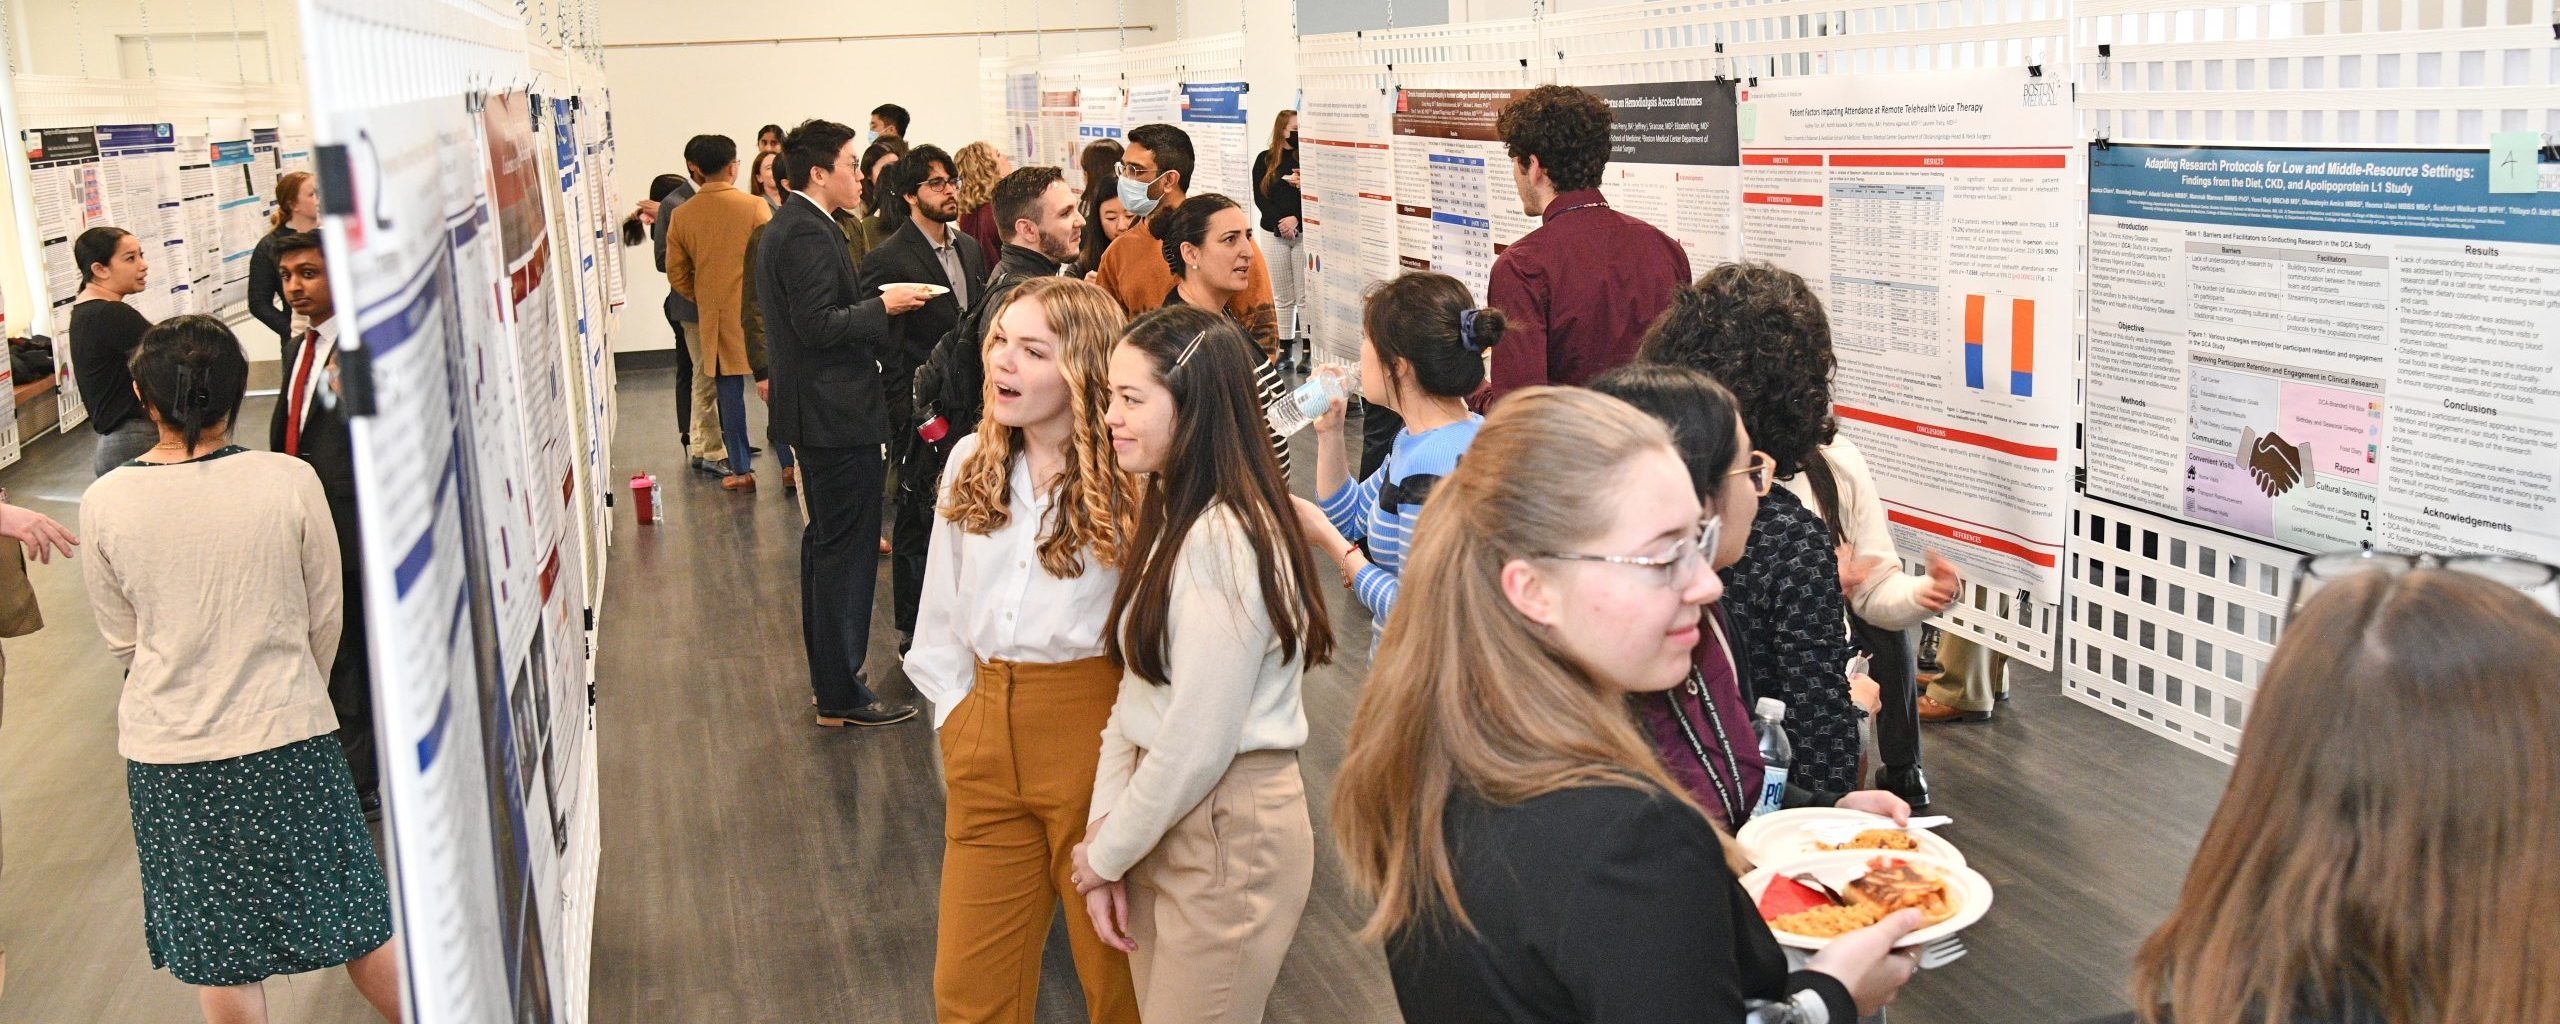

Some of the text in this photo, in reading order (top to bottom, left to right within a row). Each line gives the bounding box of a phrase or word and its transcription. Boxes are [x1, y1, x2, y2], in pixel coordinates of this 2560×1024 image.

[2024, 82, 2054, 96] BOSTON
[1624, 98, 1658, 109] Hemodialysis
[1658, 98, 1676, 107] Access
[1676, 97, 1702, 107] Outcomes
[2023, 95, 2057, 107] MEDICAL
[1790, 103, 1983, 118] Patient Factors Impacting Attendance at Remote Telehealth Voice Therapy
[1674, 122, 1690, 130] Elizabeth
[1690, 122, 1700, 130] King,
[1611, 135, 1622, 143] School
[1655, 135, 1670, 143] Medical
[1670, 135, 1682, 143] Center
[1681, 134, 1704, 144] Department
[2144, 157, 2474, 182] Adapting Research Protocols for Low and Middle-Resource Settings:
[2182, 175, 2412, 196] Findings from the Diet, CKD, and Apolipoprotein L1 Study
[2117, 221, 2148, 231] Introduction
[2202, 231, 2222, 239] Barriers
[2222, 232, 2232, 240] and
[2232, 233, 2260, 242] Facilitators
[2260, 235, 2267, 243] to
[2267, 235, 2297, 247] Conducting
[2297, 237, 2323, 246] Research
[2323, 239, 2330, 247] in
[2329, 239, 2339, 247] the
[2339, 240, 2354, 248] DCA
[2354, 241, 2371, 251] Study
[2222, 246, 2241, 254] Barriers
[2465, 245, 2499, 257] Results
[2317, 254, 2347, 264] Facilitators
[2400, 256, 2414, 264] Lack
[2422, 258, 2465, 269] understanding
[2483, 262, 2494, 270] the
[2412, 268, 2444, 276] addressed
[2444, 270, 2453, 278] by
[2453, 270, 2482, 280] improving
[2482, 274, 2528, 283] communication
[2528, 276, 2541, 284] with
[2400, 306, 2412, 315] The
[2412, 307, 2433, 317] burden
[2440, 310, 2454, 319] data
[2454, 312, 2481, 322] collection
[2494, 316, 2526, 326] addressed
[2526, 319, 2534, 328] by
[2118, 321, 2145, 333] Objective
[2188, 330, 2203, 339] Figure
[2207, 332, 2225, 341] Various
[2225, 335, 2250, 345] strategies
[2250, 339, 2274, 349] employed
[2274, 341, 2282, 349] for
[2282, 343, 2311, 354] participant
[2311, 347, 2336, 357] retention
[2336, 351, 2348, 359] and
[2348, 353, 2383, 363] engagement
[2192, 339, 2200, 347] the
[2200, 340, 2212, 348] DCA
[2211, 342, 2225, 351] Study
[2192, 354, 2379, 389] Improving Participant Retention and Engagement in Clinical Research
[2121, 395, 2146, 408] Methods
[2443, 399, 2497, 416] Conclusions
[1917, 426, 1946, 437] CONCLUSIONS
[2192, 433, 2232, 447] Communication
[2189, 453, 2234, 469] Convenient Visits
[2334, 462, 2360, 475] Rapport
[2316, 481, 2376, 503] Cultural Sensitivity
[2423, 506, 2513, 532] Acknowledgements
[1952, 530, 1982, 544] REFERENCES
[1706, 702, 1715, 711] of
[1711, 711, 1726, 739] School
[1680, 715, 1703, 755] University
[1701, 753, 1718, 781] School
[1716, 779, 1723, 790] of
[1723, 739, 1740, 782] University
